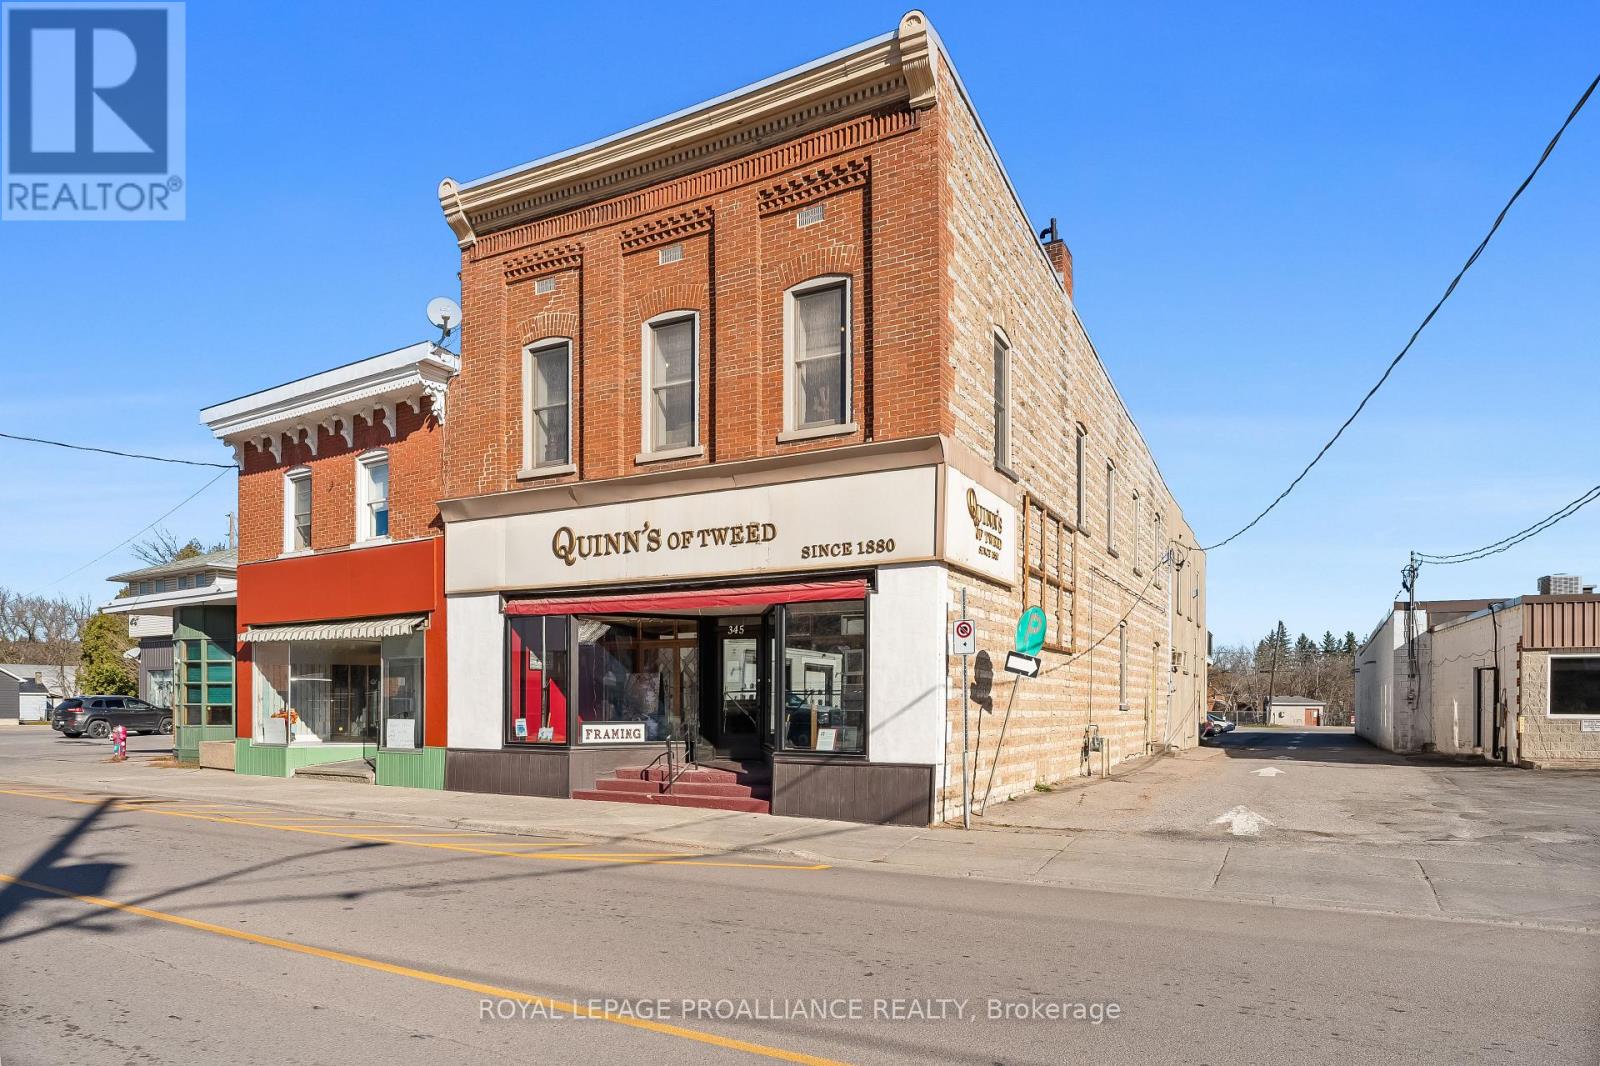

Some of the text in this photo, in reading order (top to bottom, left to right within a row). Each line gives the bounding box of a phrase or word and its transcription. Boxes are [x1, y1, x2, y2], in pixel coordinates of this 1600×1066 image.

[552, 520, 777, 566] QUINN'S OF TWEED
[801, 538, 895, 559] SINCE 1880
[727, 624, 745, 635] 345
[585, 728, 641, 740] FRAMING
